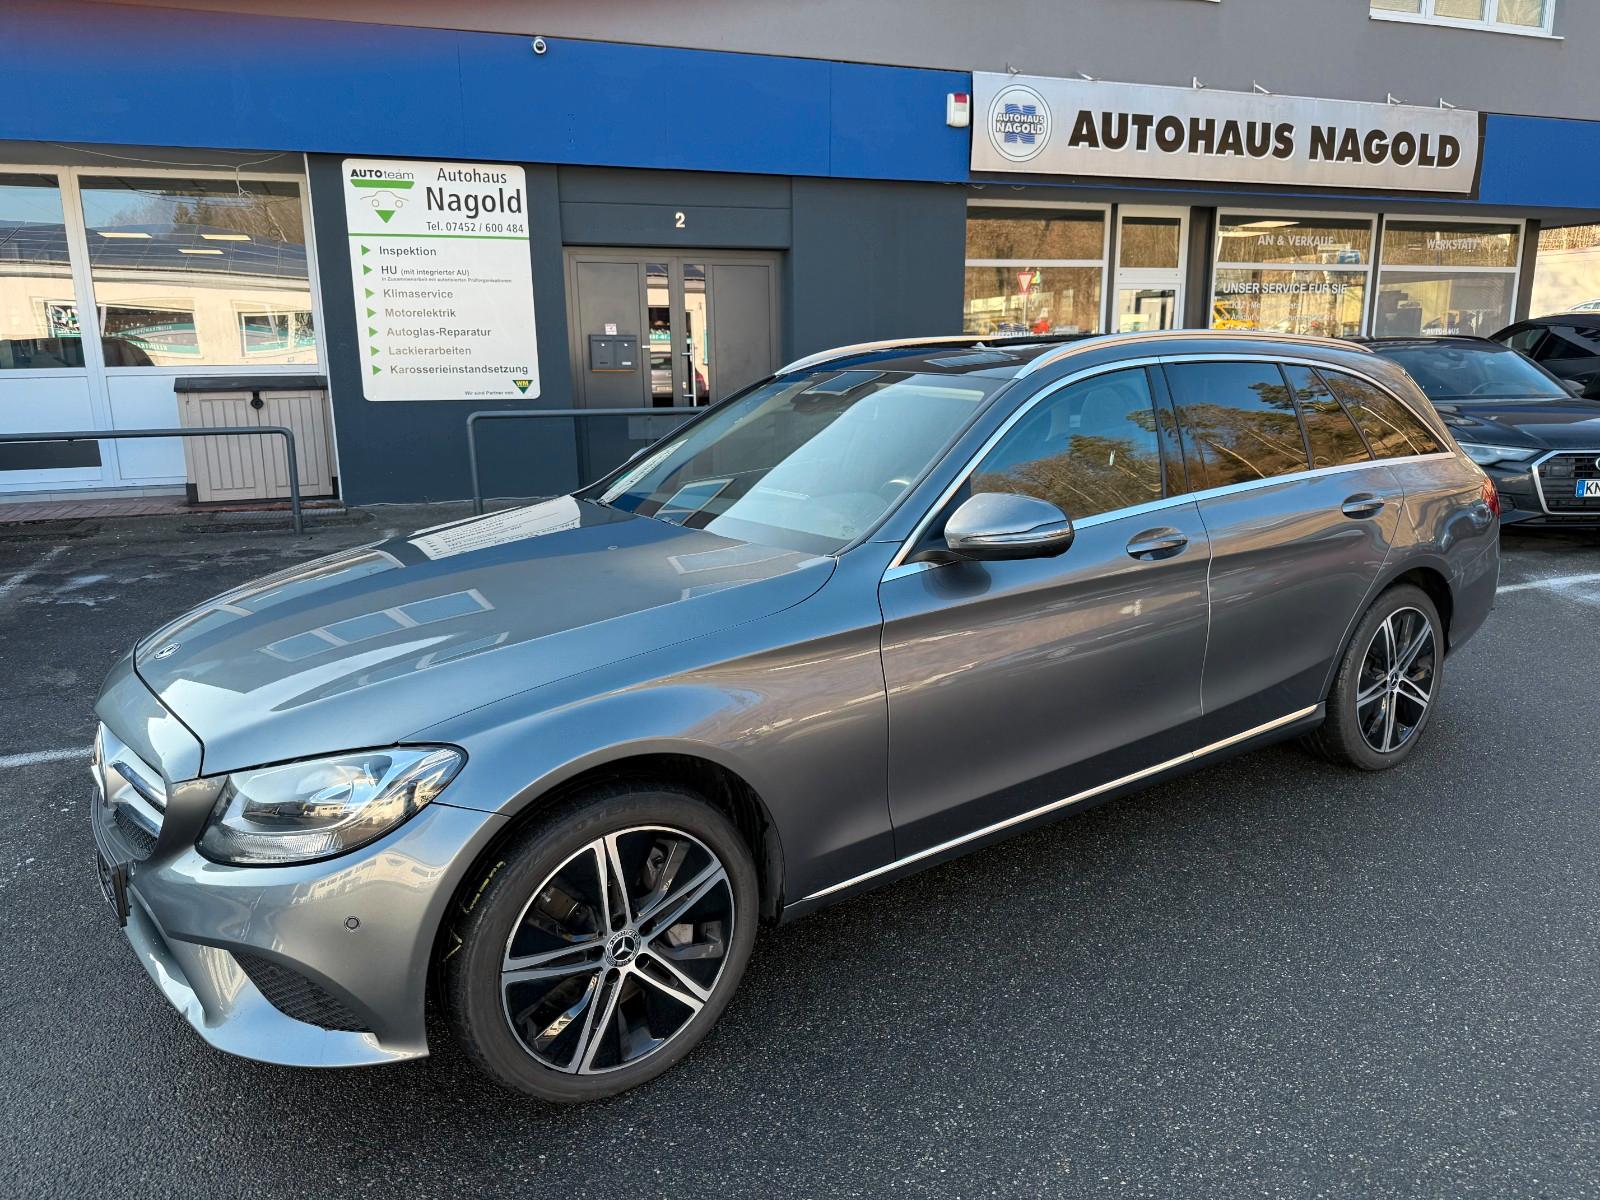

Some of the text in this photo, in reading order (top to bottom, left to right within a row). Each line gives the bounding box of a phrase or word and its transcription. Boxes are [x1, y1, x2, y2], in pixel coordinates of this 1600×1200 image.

[996, 112, 1045, 124] AUTOHAUS
[996, 121, 1045, 135] NAGOLD
[1067, 109, 1461, 169] AUTOHAUS NAGOLD
[437, 167, 507, 184] Autohaus
[426, 186, 522, 219] Nagold
[675, 212, 686, 228] 2
[426, 221, 443, 231] Tel.
[445, 222, 476, 232] 07452
[485, 223, 503, 233] 600
[506, 223, 524, 233] 484
[1257, 234, 1335, 247] AN & VERKAUF
[1427, 238, 1478, 250] WERKSTATT
[379, 246, 437, 257] Inspektion
[381, 265, 470, 277] HU (mit integrierter AU)
[383, 288, 454, 299] Klimaservice
[1223, 282, 1260, 294] UNSER
[1262, 283, 1306, 294] SERVICE
[1331, 283, 1348, 294] SIE
[385, 308, 457, 318] Motorelektrik
[386, 327, 492, 338] Autoglas-Reparatur
[388, 346, 472, 356] Lackierarbeiten
[390, 364, 529, 375] Karosserieinstandsetzung
